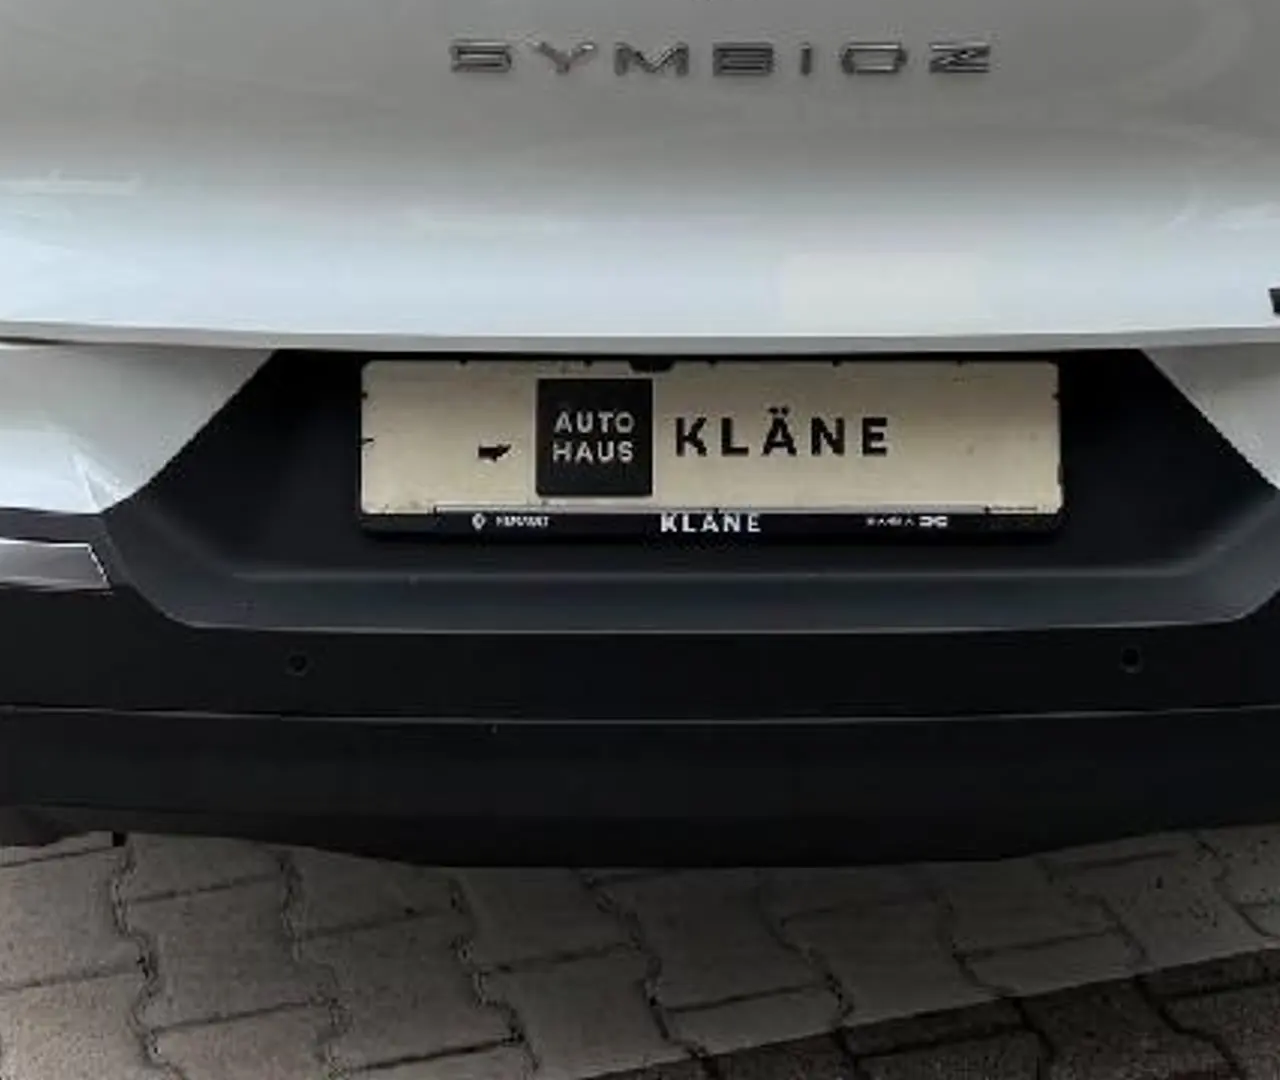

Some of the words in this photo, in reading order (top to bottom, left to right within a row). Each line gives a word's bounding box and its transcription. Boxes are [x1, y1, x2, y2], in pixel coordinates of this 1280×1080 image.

[450, 41, 991, 76] SYMBIOZ
[553, 411, 636, 435] AUTO
[675, 407, 889, 457] KLÄNE
[552, 441, 635, 463] HAUS
